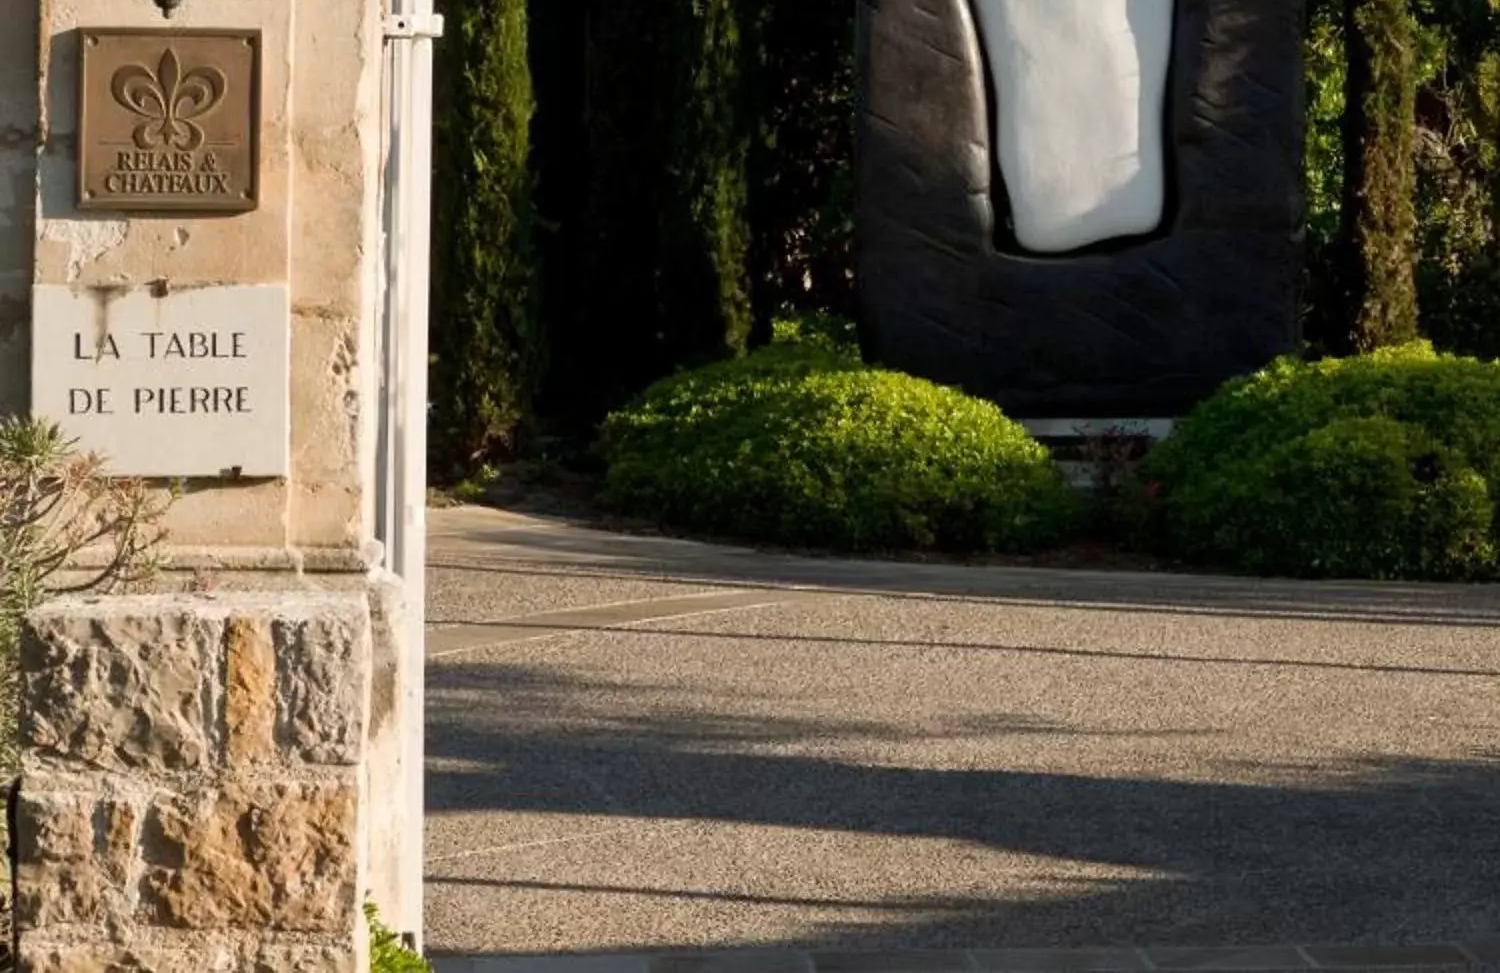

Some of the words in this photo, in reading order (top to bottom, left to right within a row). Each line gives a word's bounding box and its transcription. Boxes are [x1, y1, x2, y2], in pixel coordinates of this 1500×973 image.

[117, 151, 193, 171] RELAIS
[200, 152, 216, 172] &
[74, 332, 121, 361] LA
[141, 332, 247, 359] TABLE
[69, 388, 114, 415] DE
[134, 386, 253, 414] PIERRE
